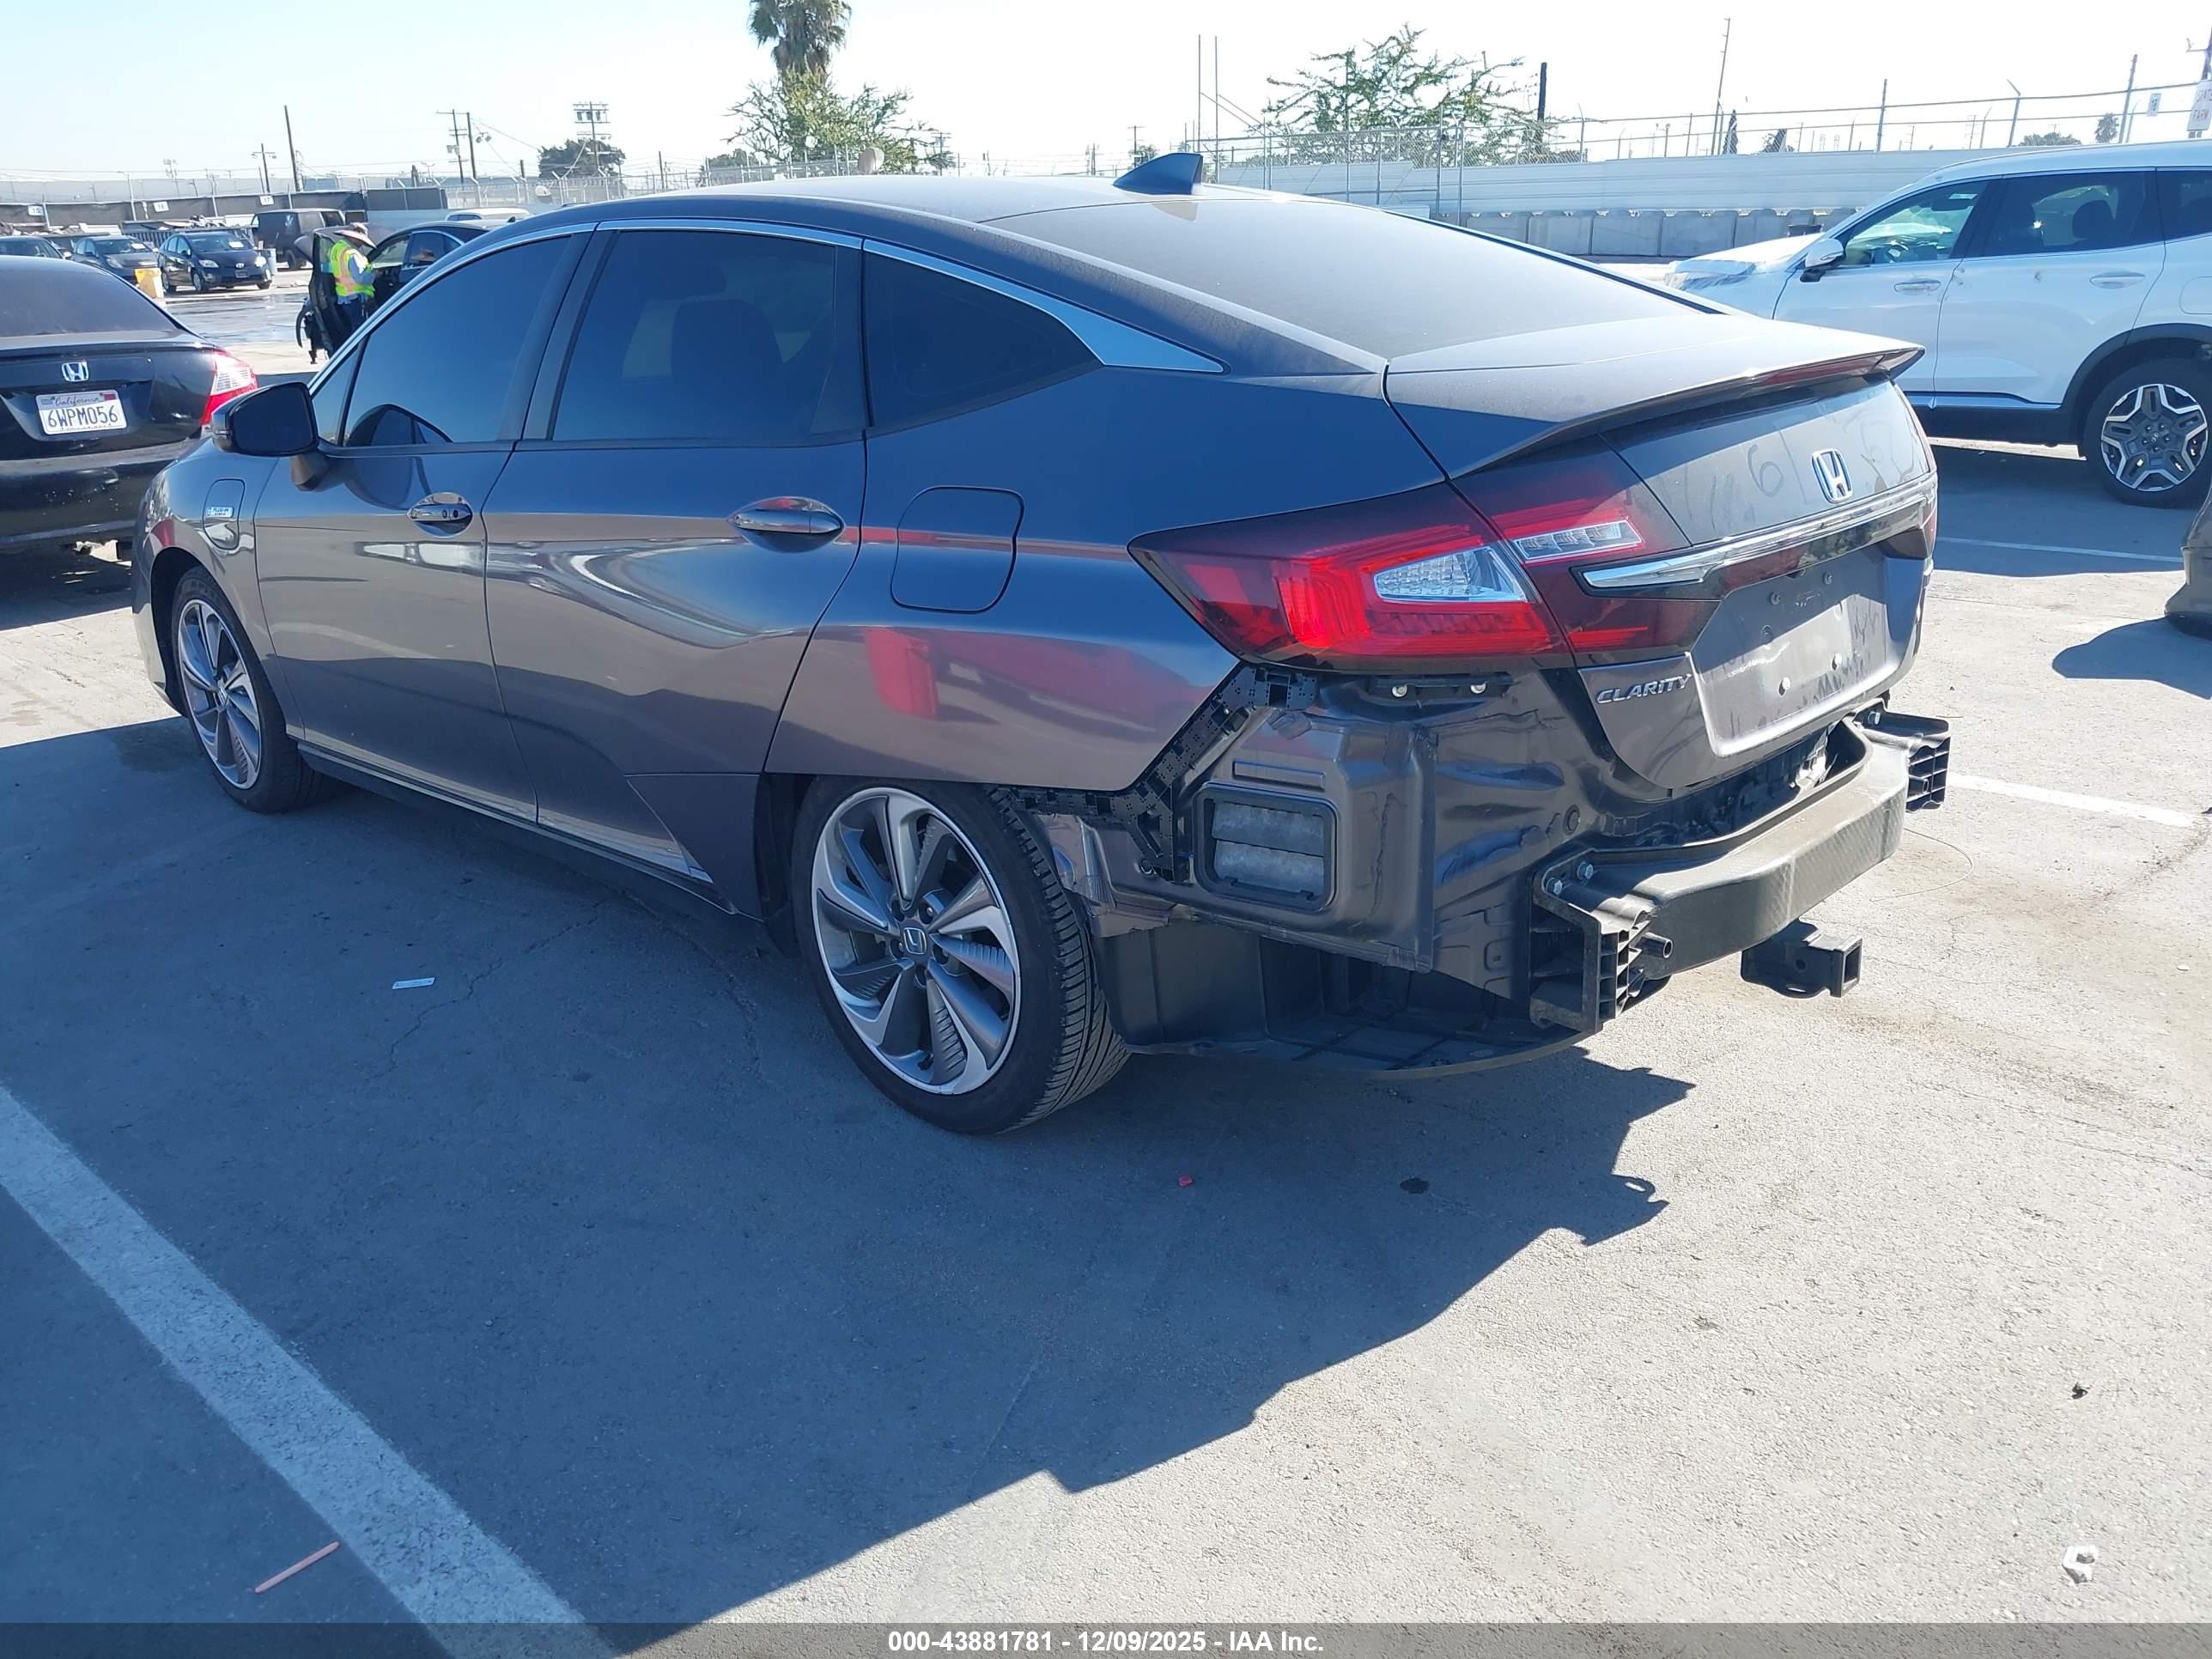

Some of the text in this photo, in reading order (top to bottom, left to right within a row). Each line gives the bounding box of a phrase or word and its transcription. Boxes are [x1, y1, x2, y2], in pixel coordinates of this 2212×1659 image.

[55, 396, 99, 407] California
[48, 405, 118, 428] 6WPM056
[1596, 673, 1692, 704] CLARITY
